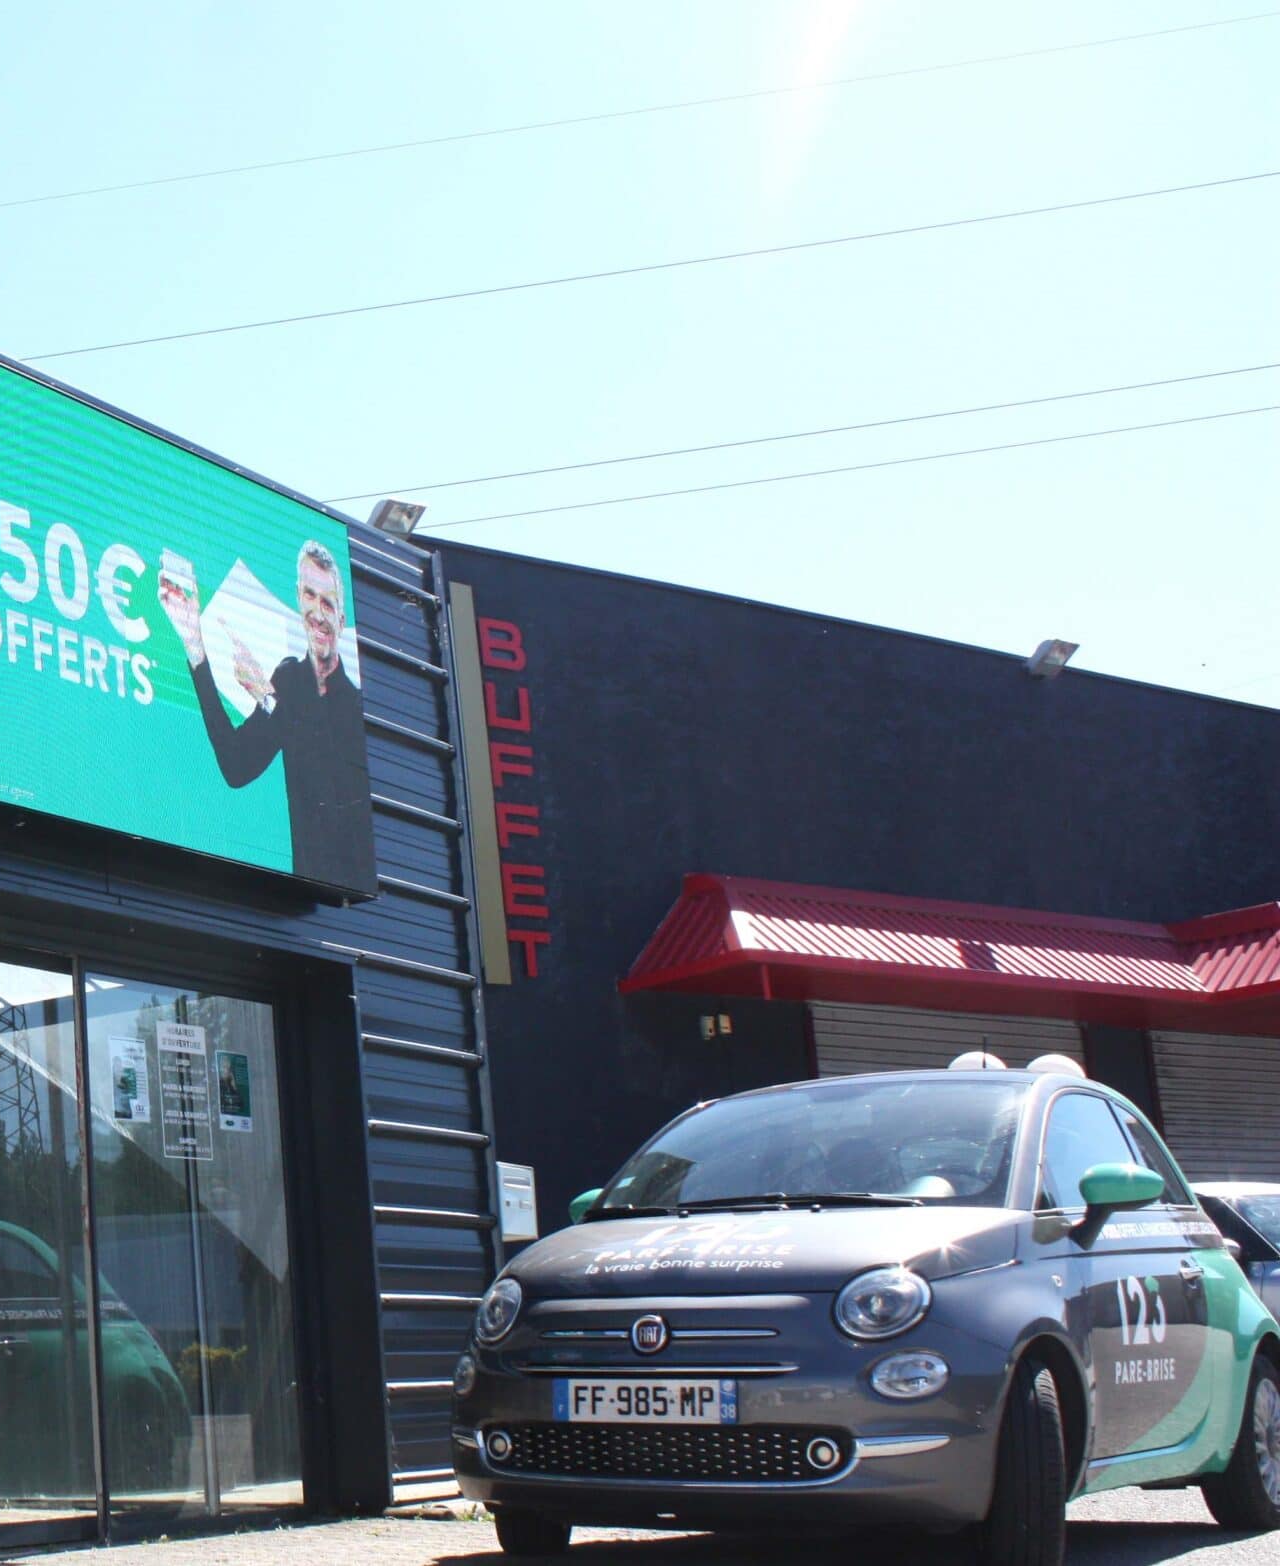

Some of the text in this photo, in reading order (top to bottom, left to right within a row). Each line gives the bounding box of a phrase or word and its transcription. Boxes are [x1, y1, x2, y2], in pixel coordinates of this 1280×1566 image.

[477, 615, 551, 978] BUFFET
[584, 1255, 785, 1276] la vraie bonne surprise
[1117, 1275, 1167, 1346] 123
[638, 1325, 660, 1343] FIAT
[1114, 1357, 1176, 1385] PARE-BRISE
[720, 1403, 737, 1419] 38
